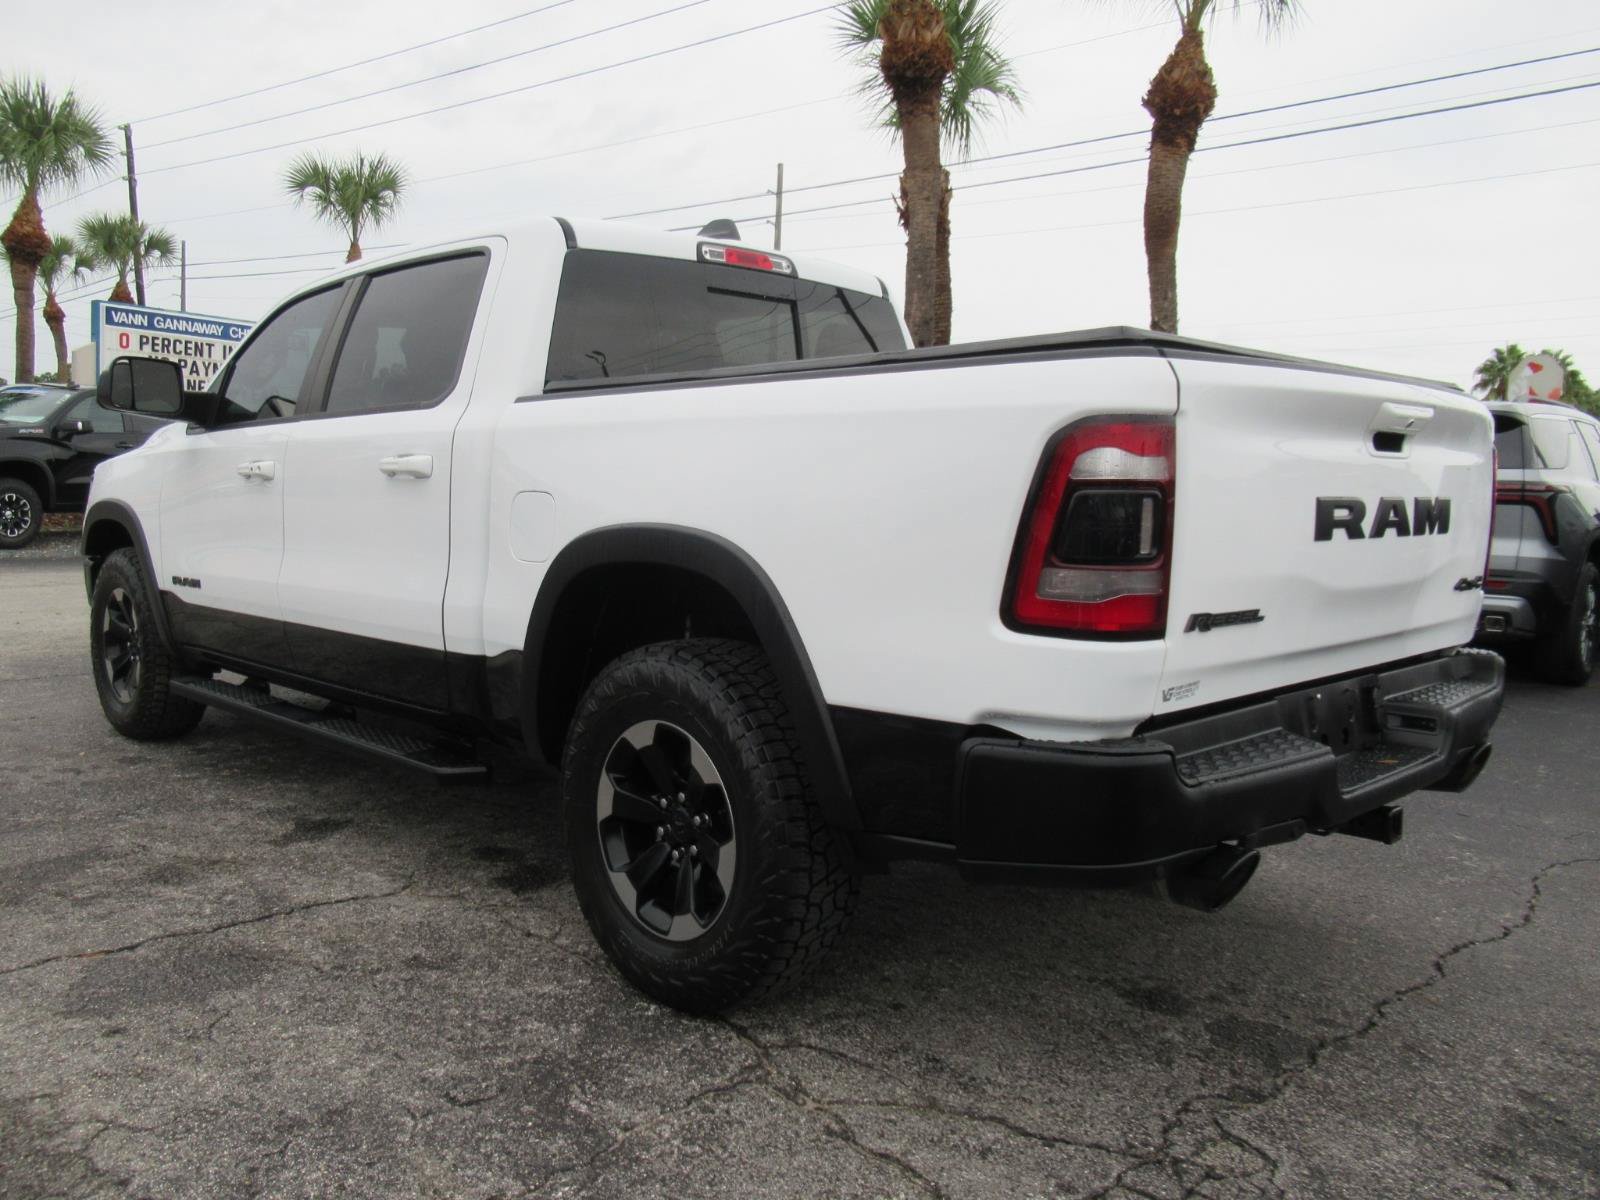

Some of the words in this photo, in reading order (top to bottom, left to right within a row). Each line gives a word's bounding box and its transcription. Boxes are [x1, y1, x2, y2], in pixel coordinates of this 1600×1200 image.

[111, 310, 148, 327] VANN
[153, 316, 224, 336] GANNAWAY
[229, 326, 251, 340] CH
[139, 334, 215, 359] PERCENT
[1314, 496, 1451, 542] RAM
